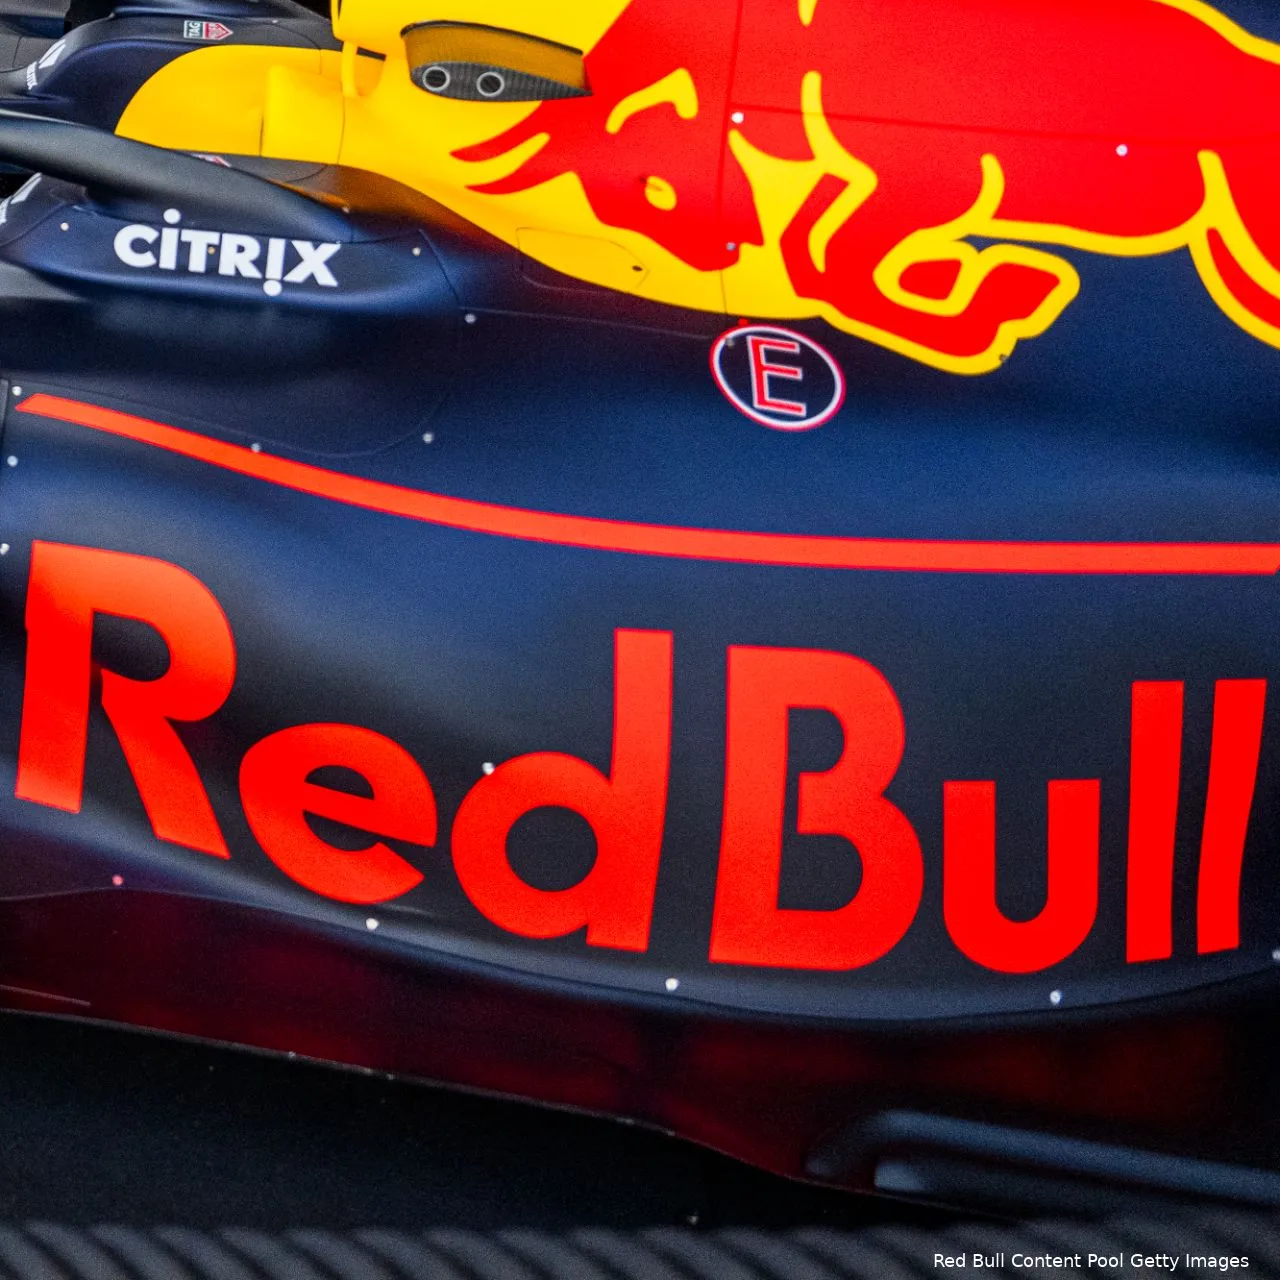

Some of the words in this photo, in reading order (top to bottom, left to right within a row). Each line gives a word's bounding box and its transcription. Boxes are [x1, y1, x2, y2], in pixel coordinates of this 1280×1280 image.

[746, 337, 808, 417] E
[14, 539, 675, 956] Red
[708, 645, 1268, 974] Bull
